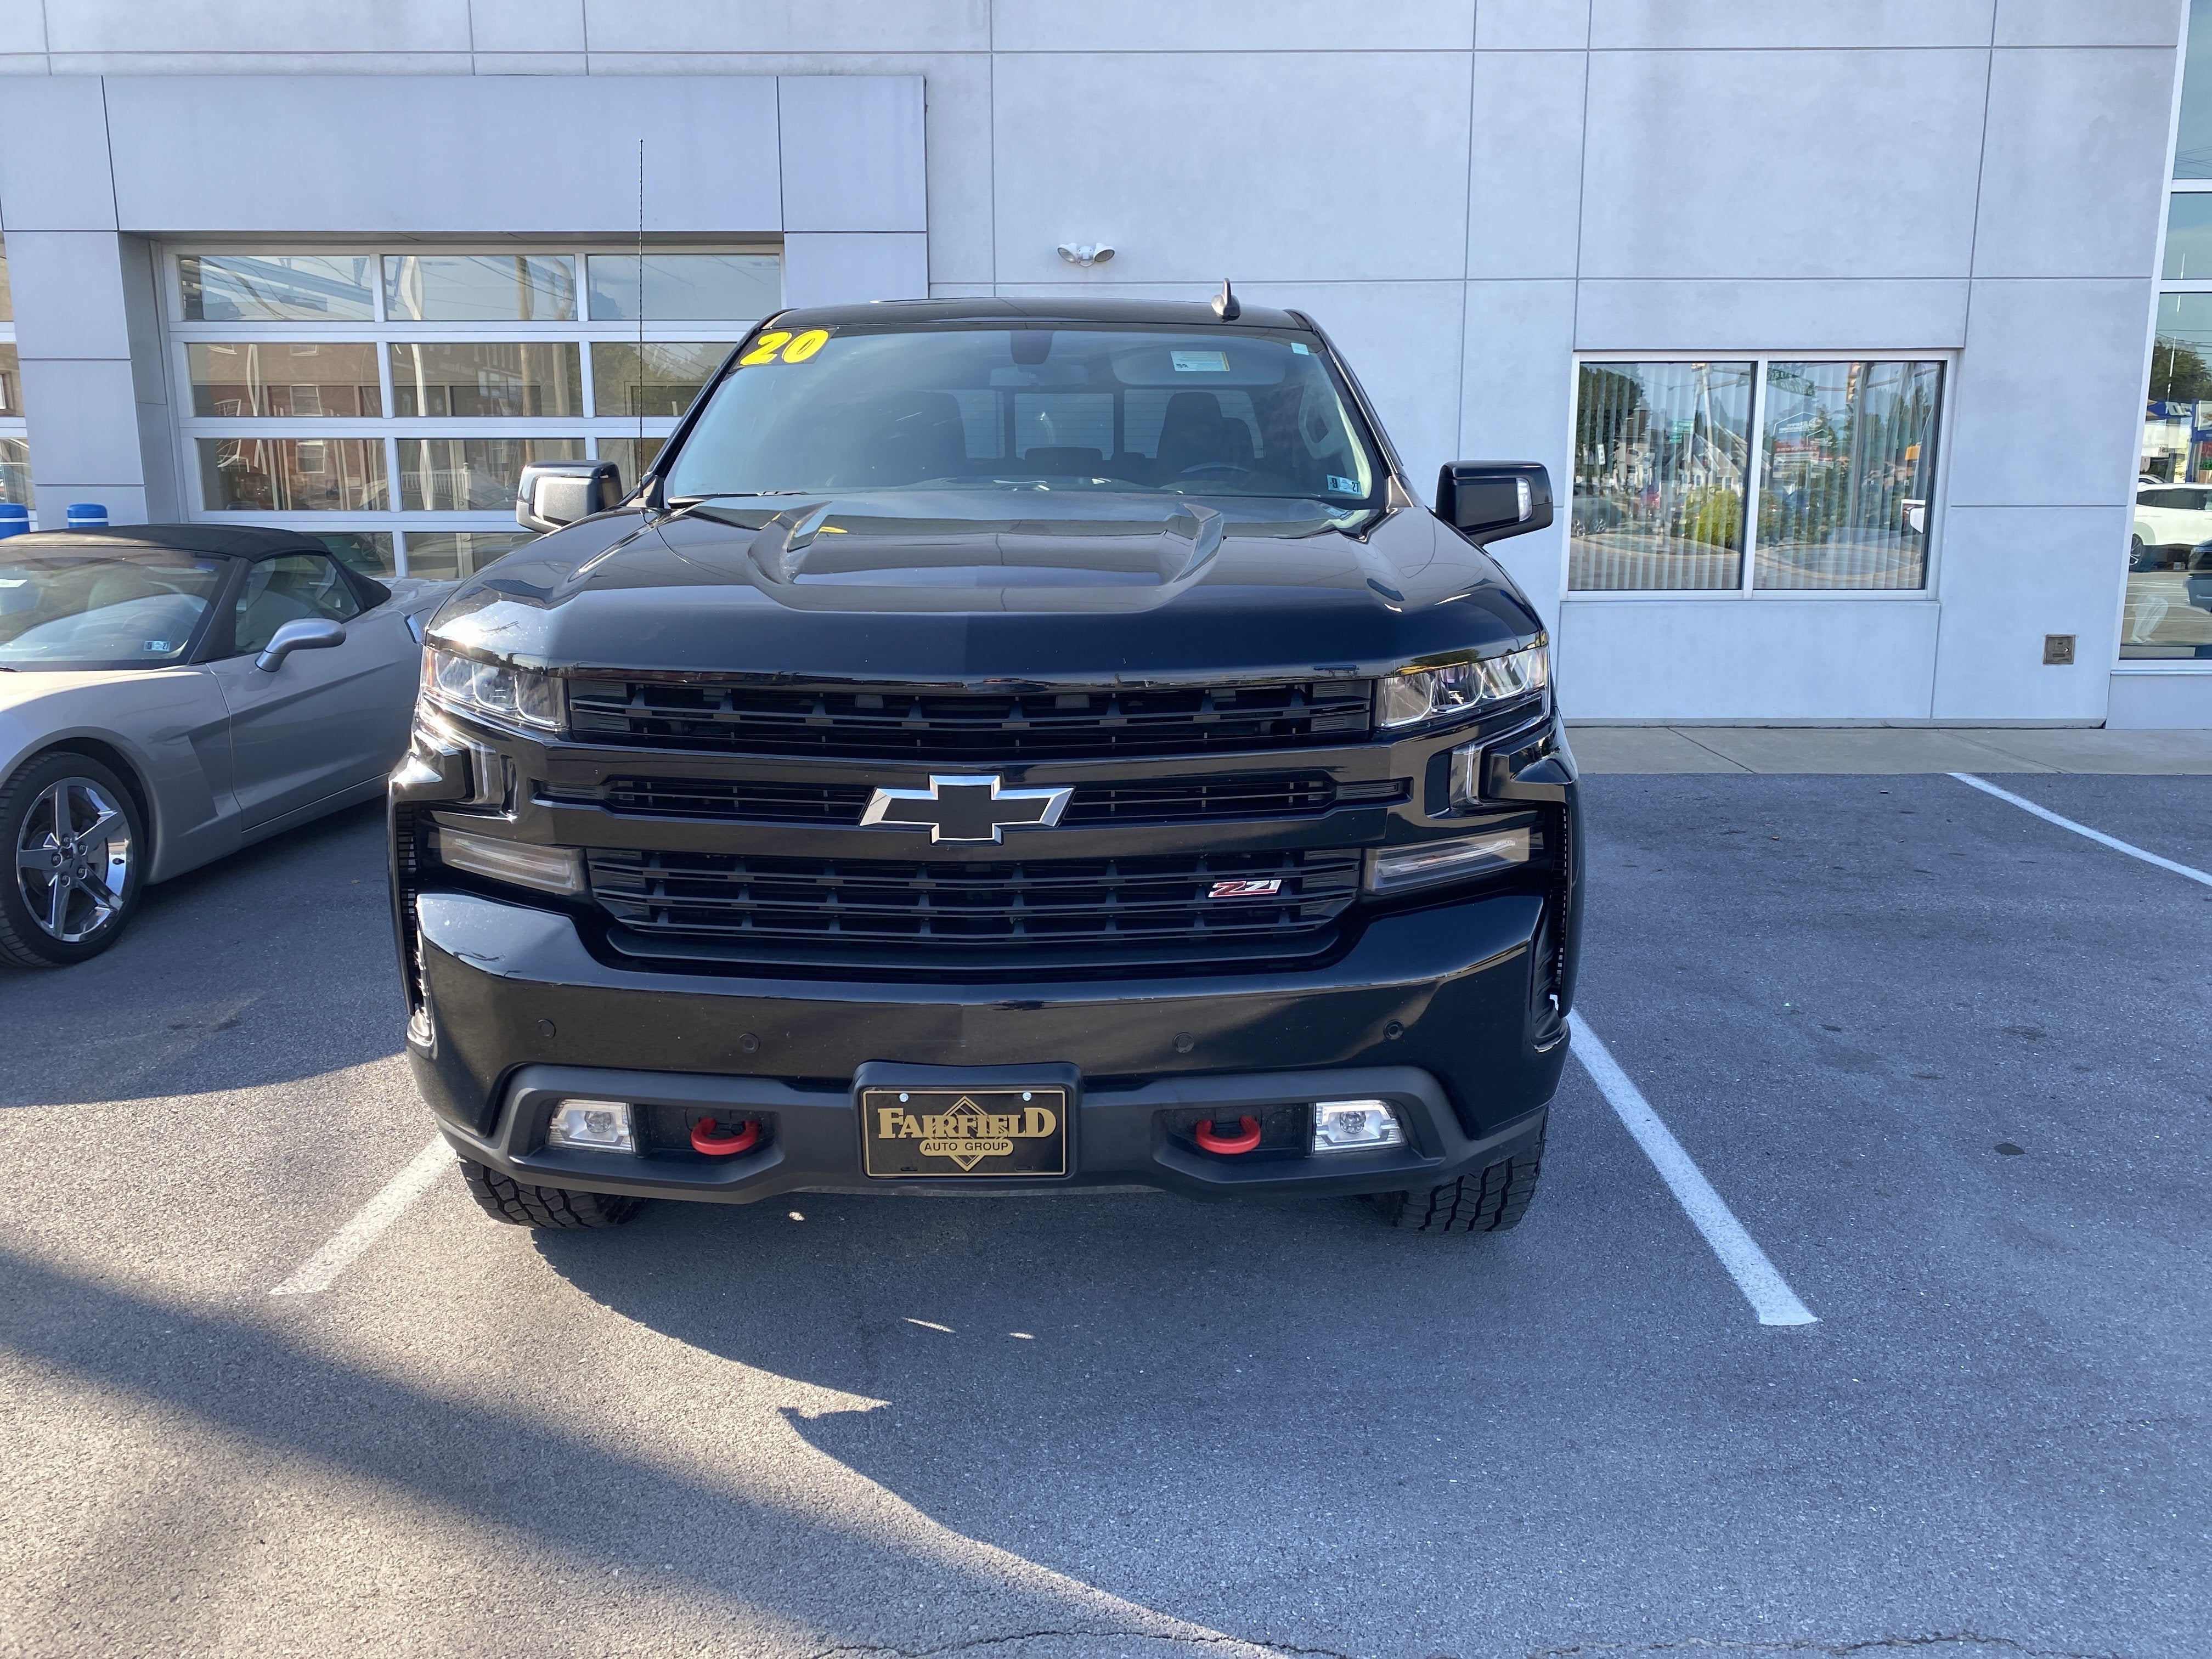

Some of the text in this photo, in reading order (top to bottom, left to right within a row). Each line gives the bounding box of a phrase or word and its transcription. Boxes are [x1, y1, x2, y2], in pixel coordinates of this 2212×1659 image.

[740, 329, 829, 365] 20
[1332, 477, 1338, 489] 9
[1208, 879, 1282, 898] Z71
[877, 1108, 1057, 1139] FAIRFIELD
[924, 1142, 1009, 1152] AUTO GROUP
